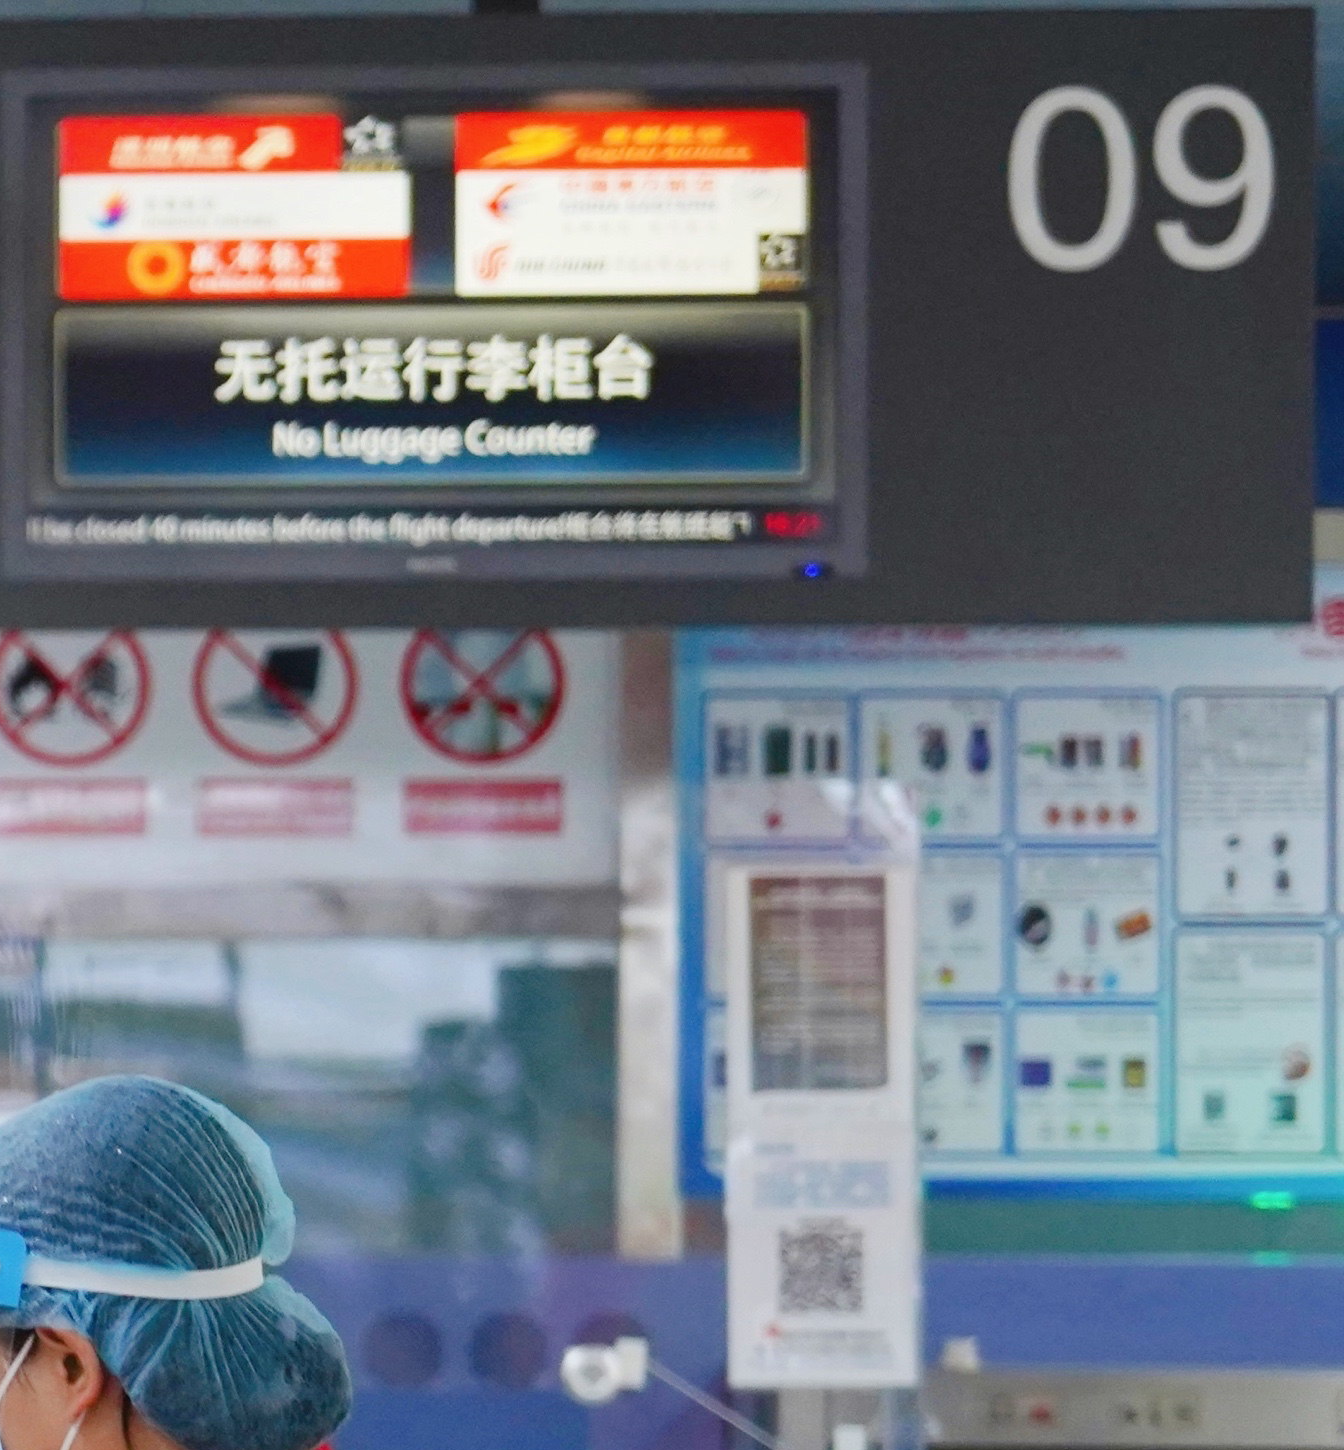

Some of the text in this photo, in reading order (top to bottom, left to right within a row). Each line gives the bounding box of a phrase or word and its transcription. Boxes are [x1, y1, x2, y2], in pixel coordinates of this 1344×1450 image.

[1007, 83, 1277, 273] 09
[213, 334, 655, 404] 无托运行李柜台
[271, 417, 598, 465] No Luggage Counter
